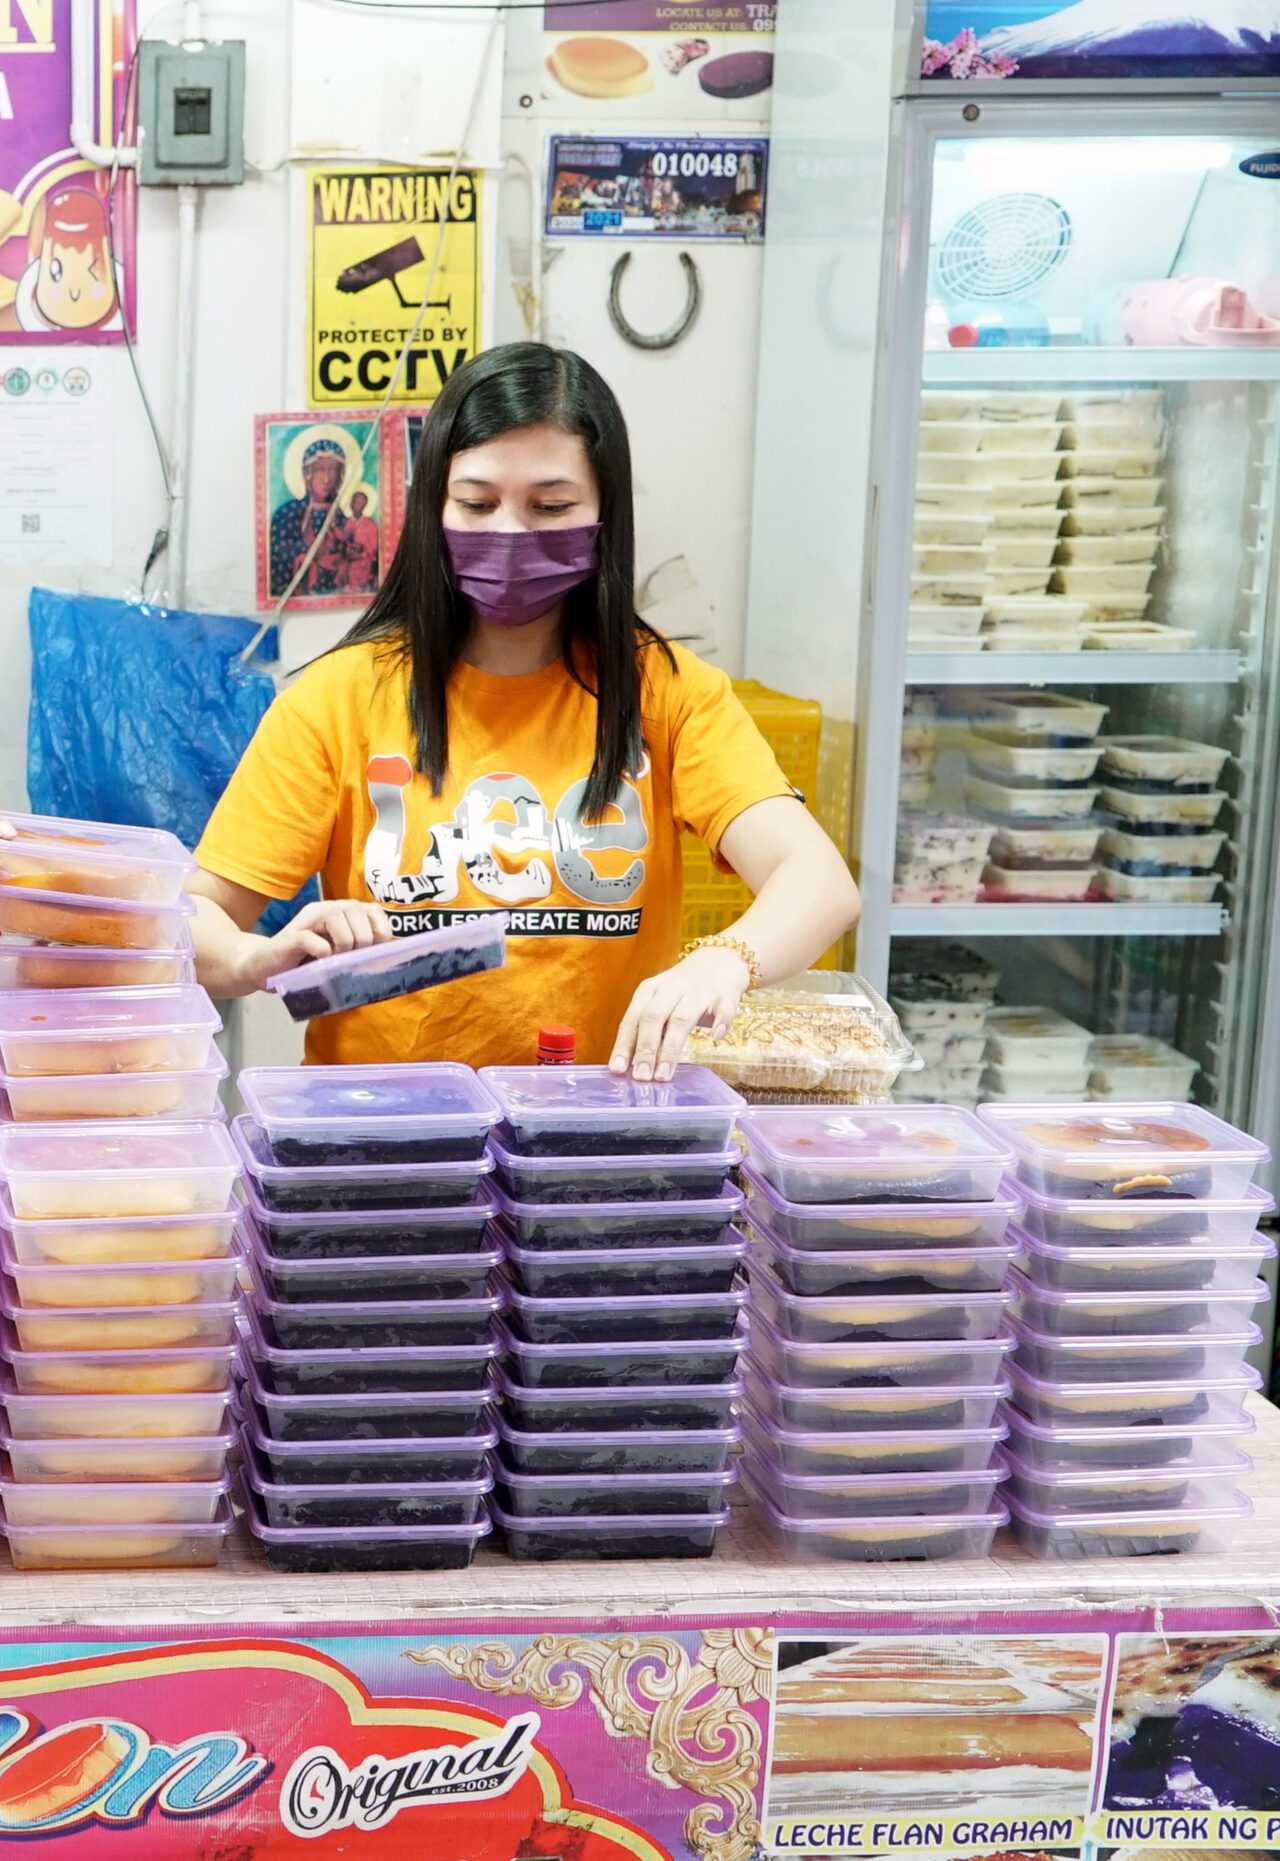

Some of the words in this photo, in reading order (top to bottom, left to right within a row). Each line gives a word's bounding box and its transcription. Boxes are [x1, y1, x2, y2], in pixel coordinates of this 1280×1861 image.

[652, 152, 739, 178] 010048
[320, 175, 474, 224] WARNING
[319, 328, 435, 344] PROTECTED
[442, 328, 468, 342] BY
[320, 349, 468, 392] CCTV
[388, 913, 433, 932] ORK
[586, 911, 640, 931] MORE
[290, 1723, 532, 1831] Original
[431, 1779, 500, 1796] est.2008
[774, 1823, 865, 1848] LECHE
[872, 1822, 945, 1847] FLAN
[952, 1820, 1073, 1845] GRAHAM
[1106, 1817, 1209, 1840] INUTAK
[1218, 1817, 1258, 1840] NG
